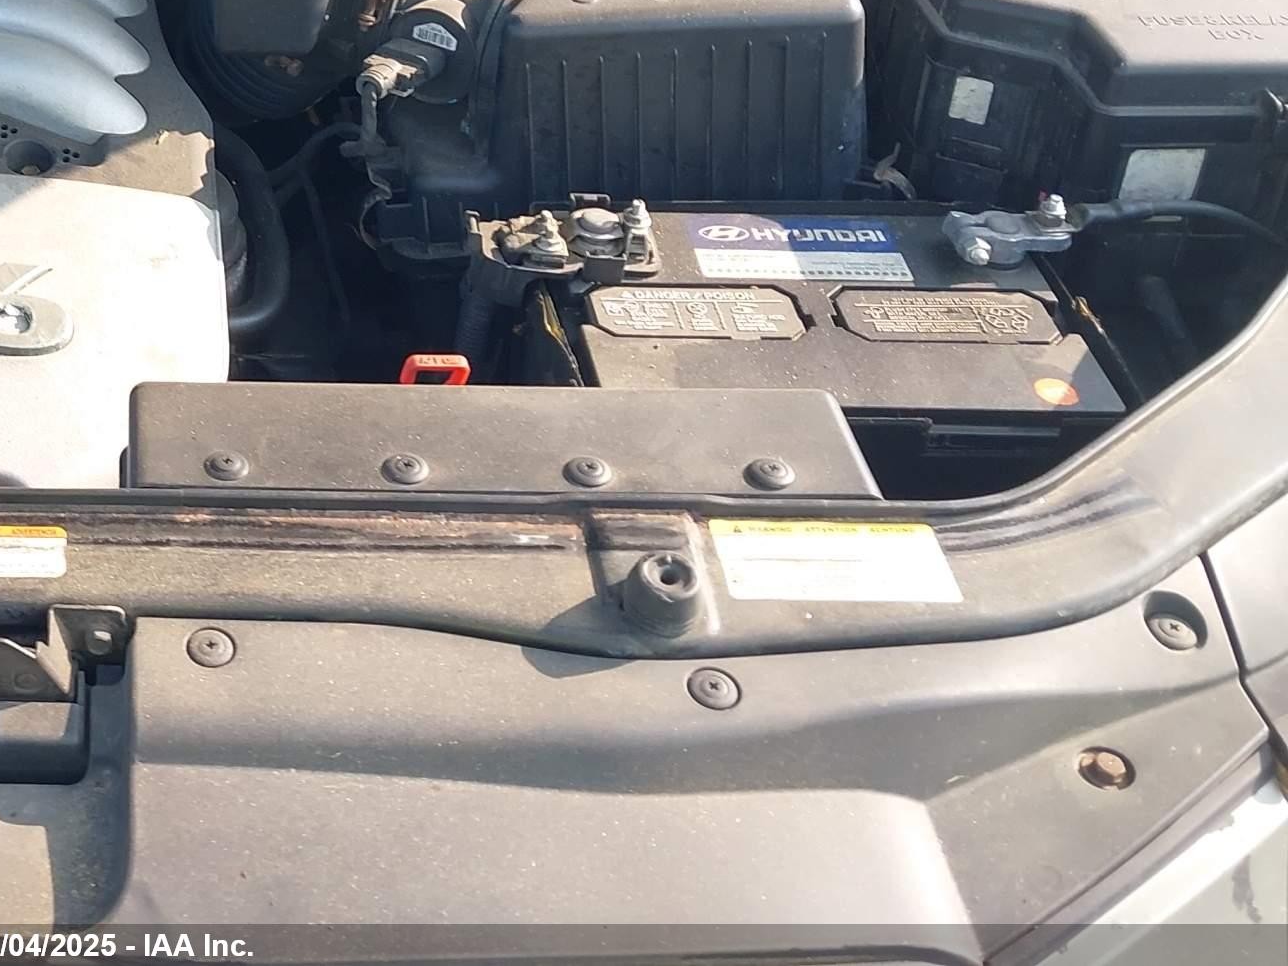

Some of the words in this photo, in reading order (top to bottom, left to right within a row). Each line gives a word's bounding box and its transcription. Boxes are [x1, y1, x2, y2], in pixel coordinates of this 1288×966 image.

[1207, 27, 1264, 41] BOX
[748, 227, 888, 244] HYUNDAI
[633, 290, 691, 300] DANGER
[704, 291, 756, 301] POISON
